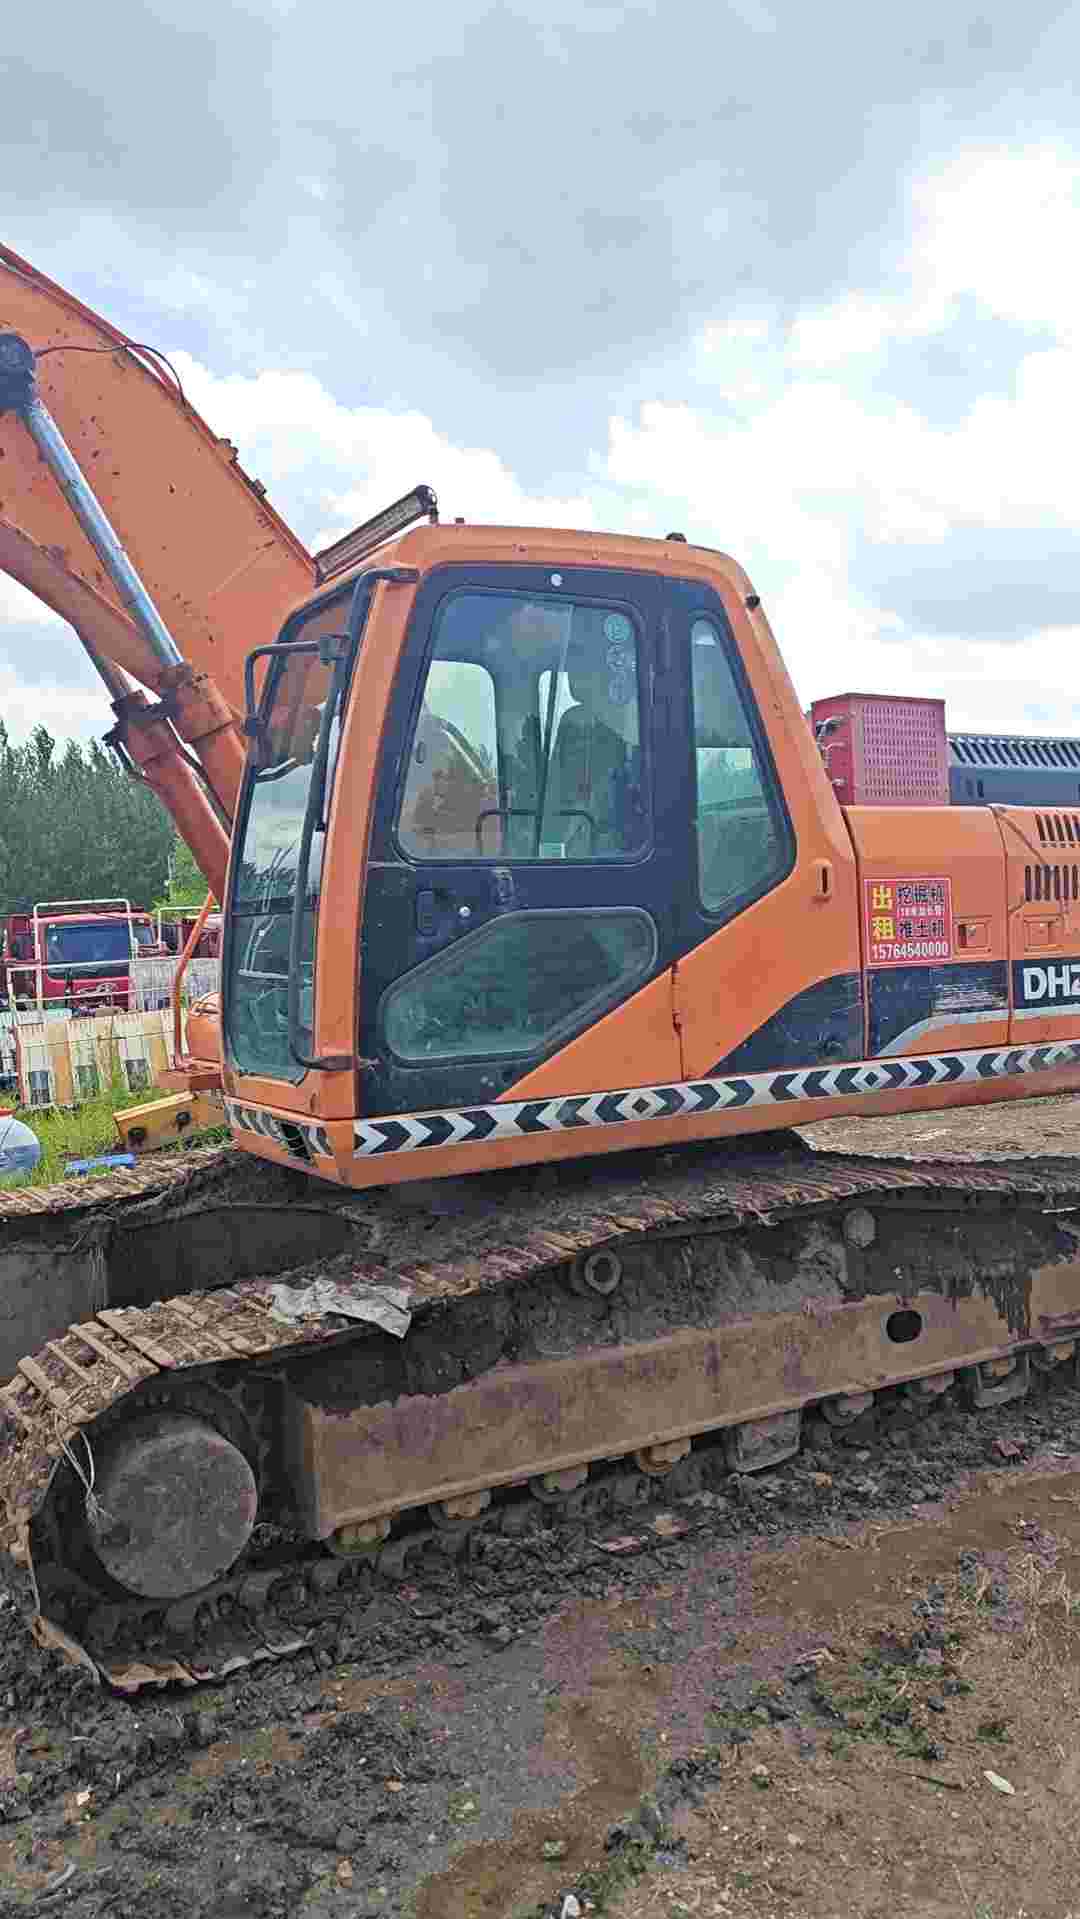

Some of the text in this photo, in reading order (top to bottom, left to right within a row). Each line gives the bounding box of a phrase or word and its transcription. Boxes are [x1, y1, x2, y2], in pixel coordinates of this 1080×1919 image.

[896, 884, 944, 904] 挖掘机
[872, 885, 895, 941] 出租
[872, 941, 949, 960] 15764540000
